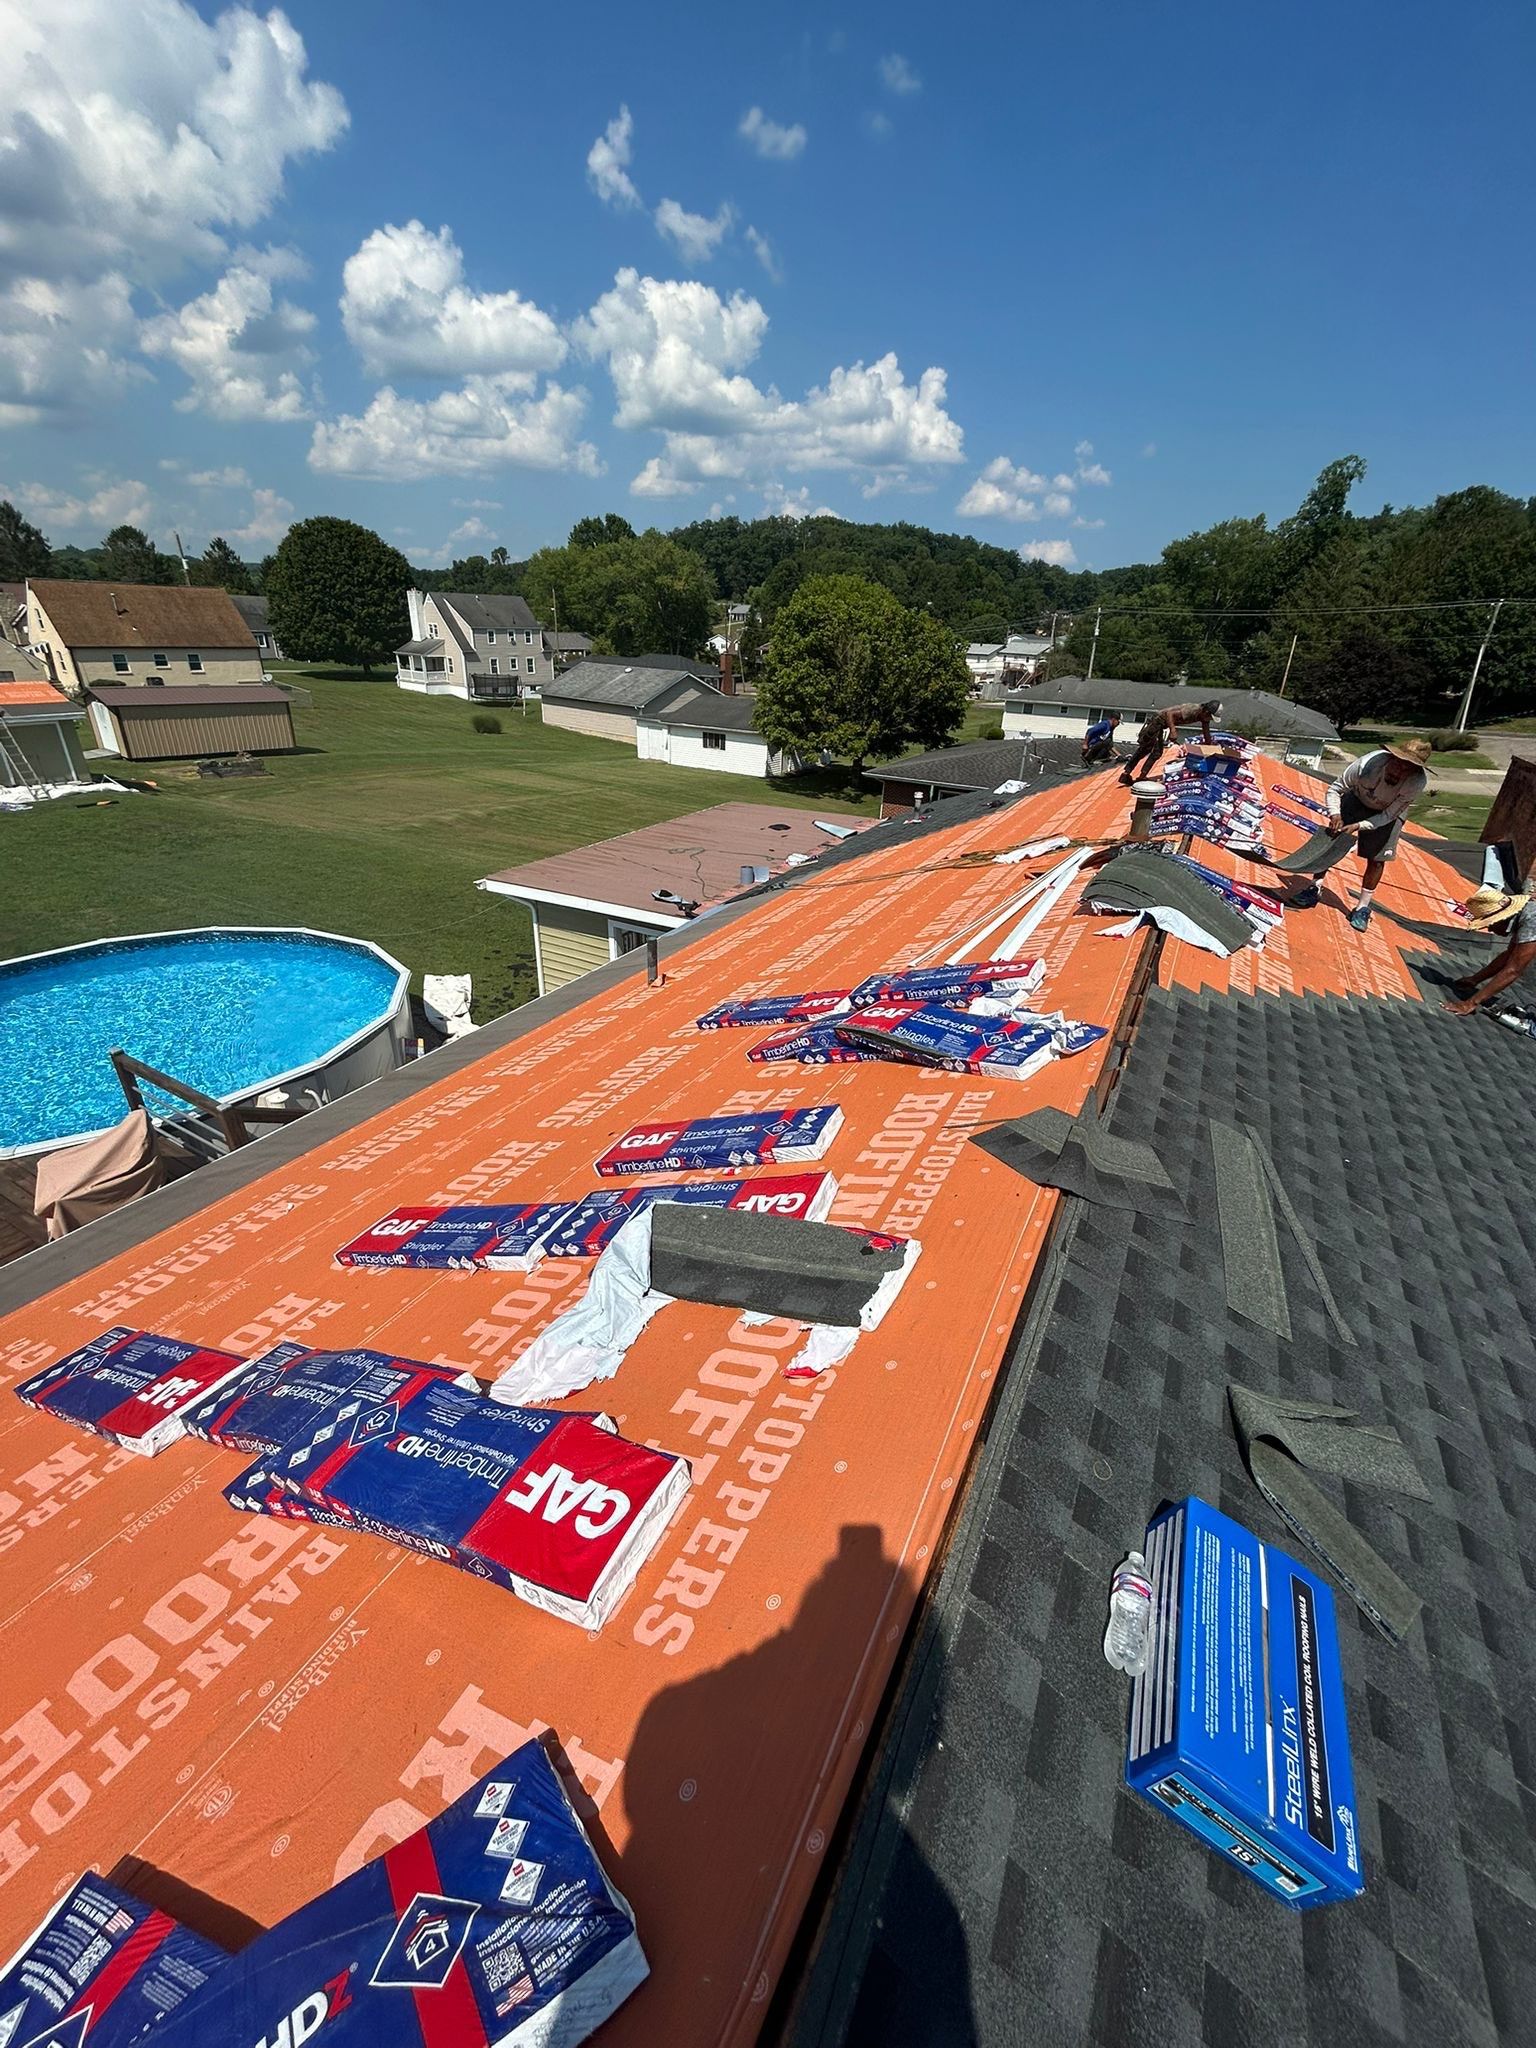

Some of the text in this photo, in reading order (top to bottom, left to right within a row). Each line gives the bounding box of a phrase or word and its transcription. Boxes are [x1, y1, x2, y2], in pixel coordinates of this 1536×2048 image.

[862, 1006, 913, 1019] GAF
[894, 1026, 936, 1046] Shingles
[536, 1045, 679, 1129] ROOFING
[335, 1083, 501, 1172] ROOFING
[620, 1130, 681, 1148] GAF
[371, 1218, 428, 1237] GAF
[84, 1183, 329, 1324] ROOFING
[479, 1407, 551, 1434] Shingles
[504, 1463, 631, 1540] GAF
[1298, 1595, 1308, 1621] NAILS
[1300, 1620, 1311, 1662] ROOFING
[265, 1626, 369, 1734] VanBoxel
[1303, 1663, 1313, 1686] COIL
[1303, 1685, 1317, 1737] COLLATED
[1281, 1699, 1304, 1830] SteelLinx
[1308, 1737, 1320, 1769] WELD
[1310, 1768, 1322, 1800] WIRE
[534, 1951, 558, 1977] MADE
